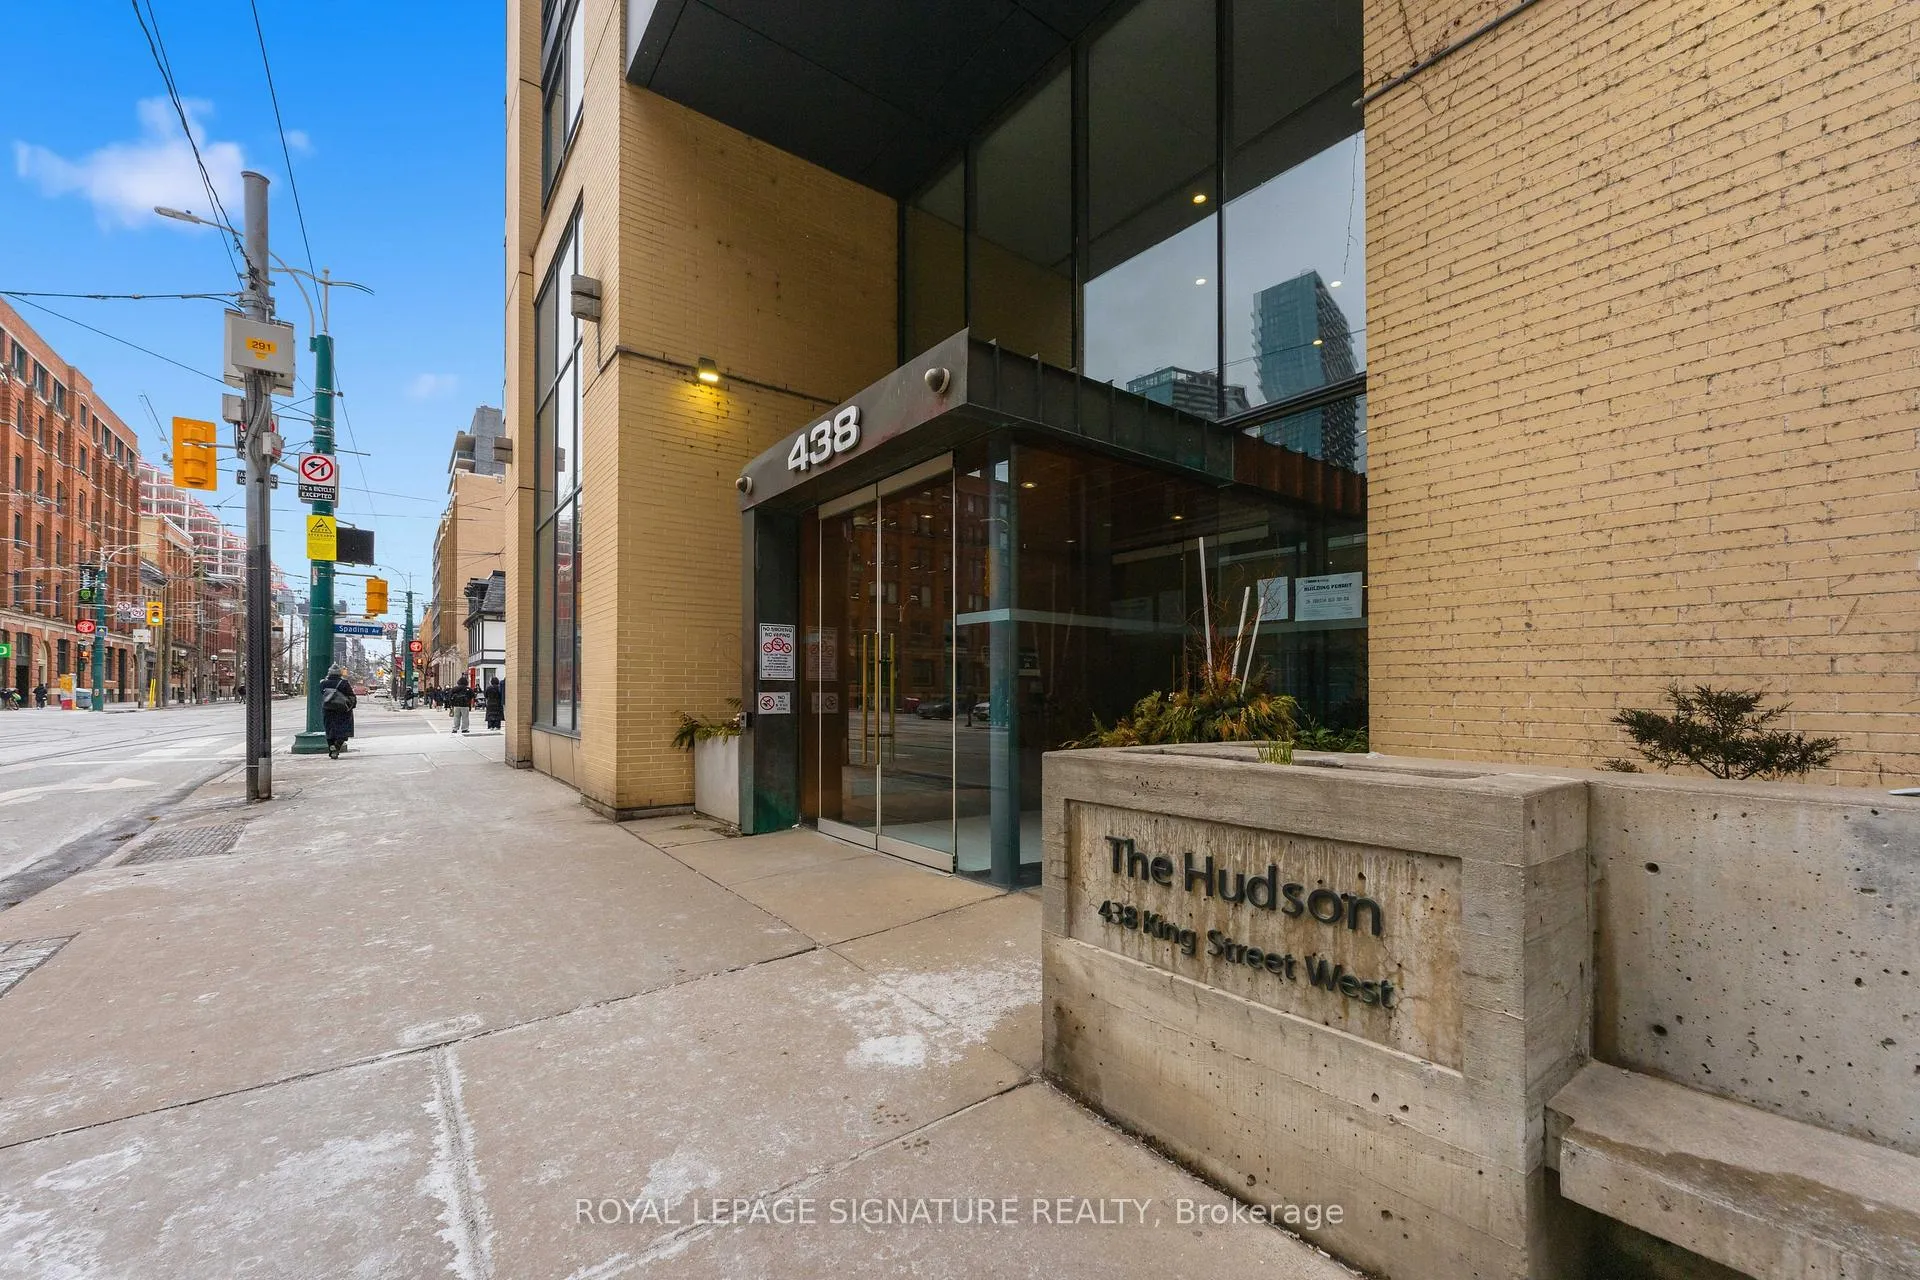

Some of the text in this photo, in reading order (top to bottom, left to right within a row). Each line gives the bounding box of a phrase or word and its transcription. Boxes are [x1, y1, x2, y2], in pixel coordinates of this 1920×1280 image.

[252, 341, 271, 351] 291
[787, 405, 860, 471] 438
[339, 625, 369, 633] Spadina
[1105, 835, 1382, 936] The Hudson
[1098, 900, 1395, 1009] 438 King Street West
